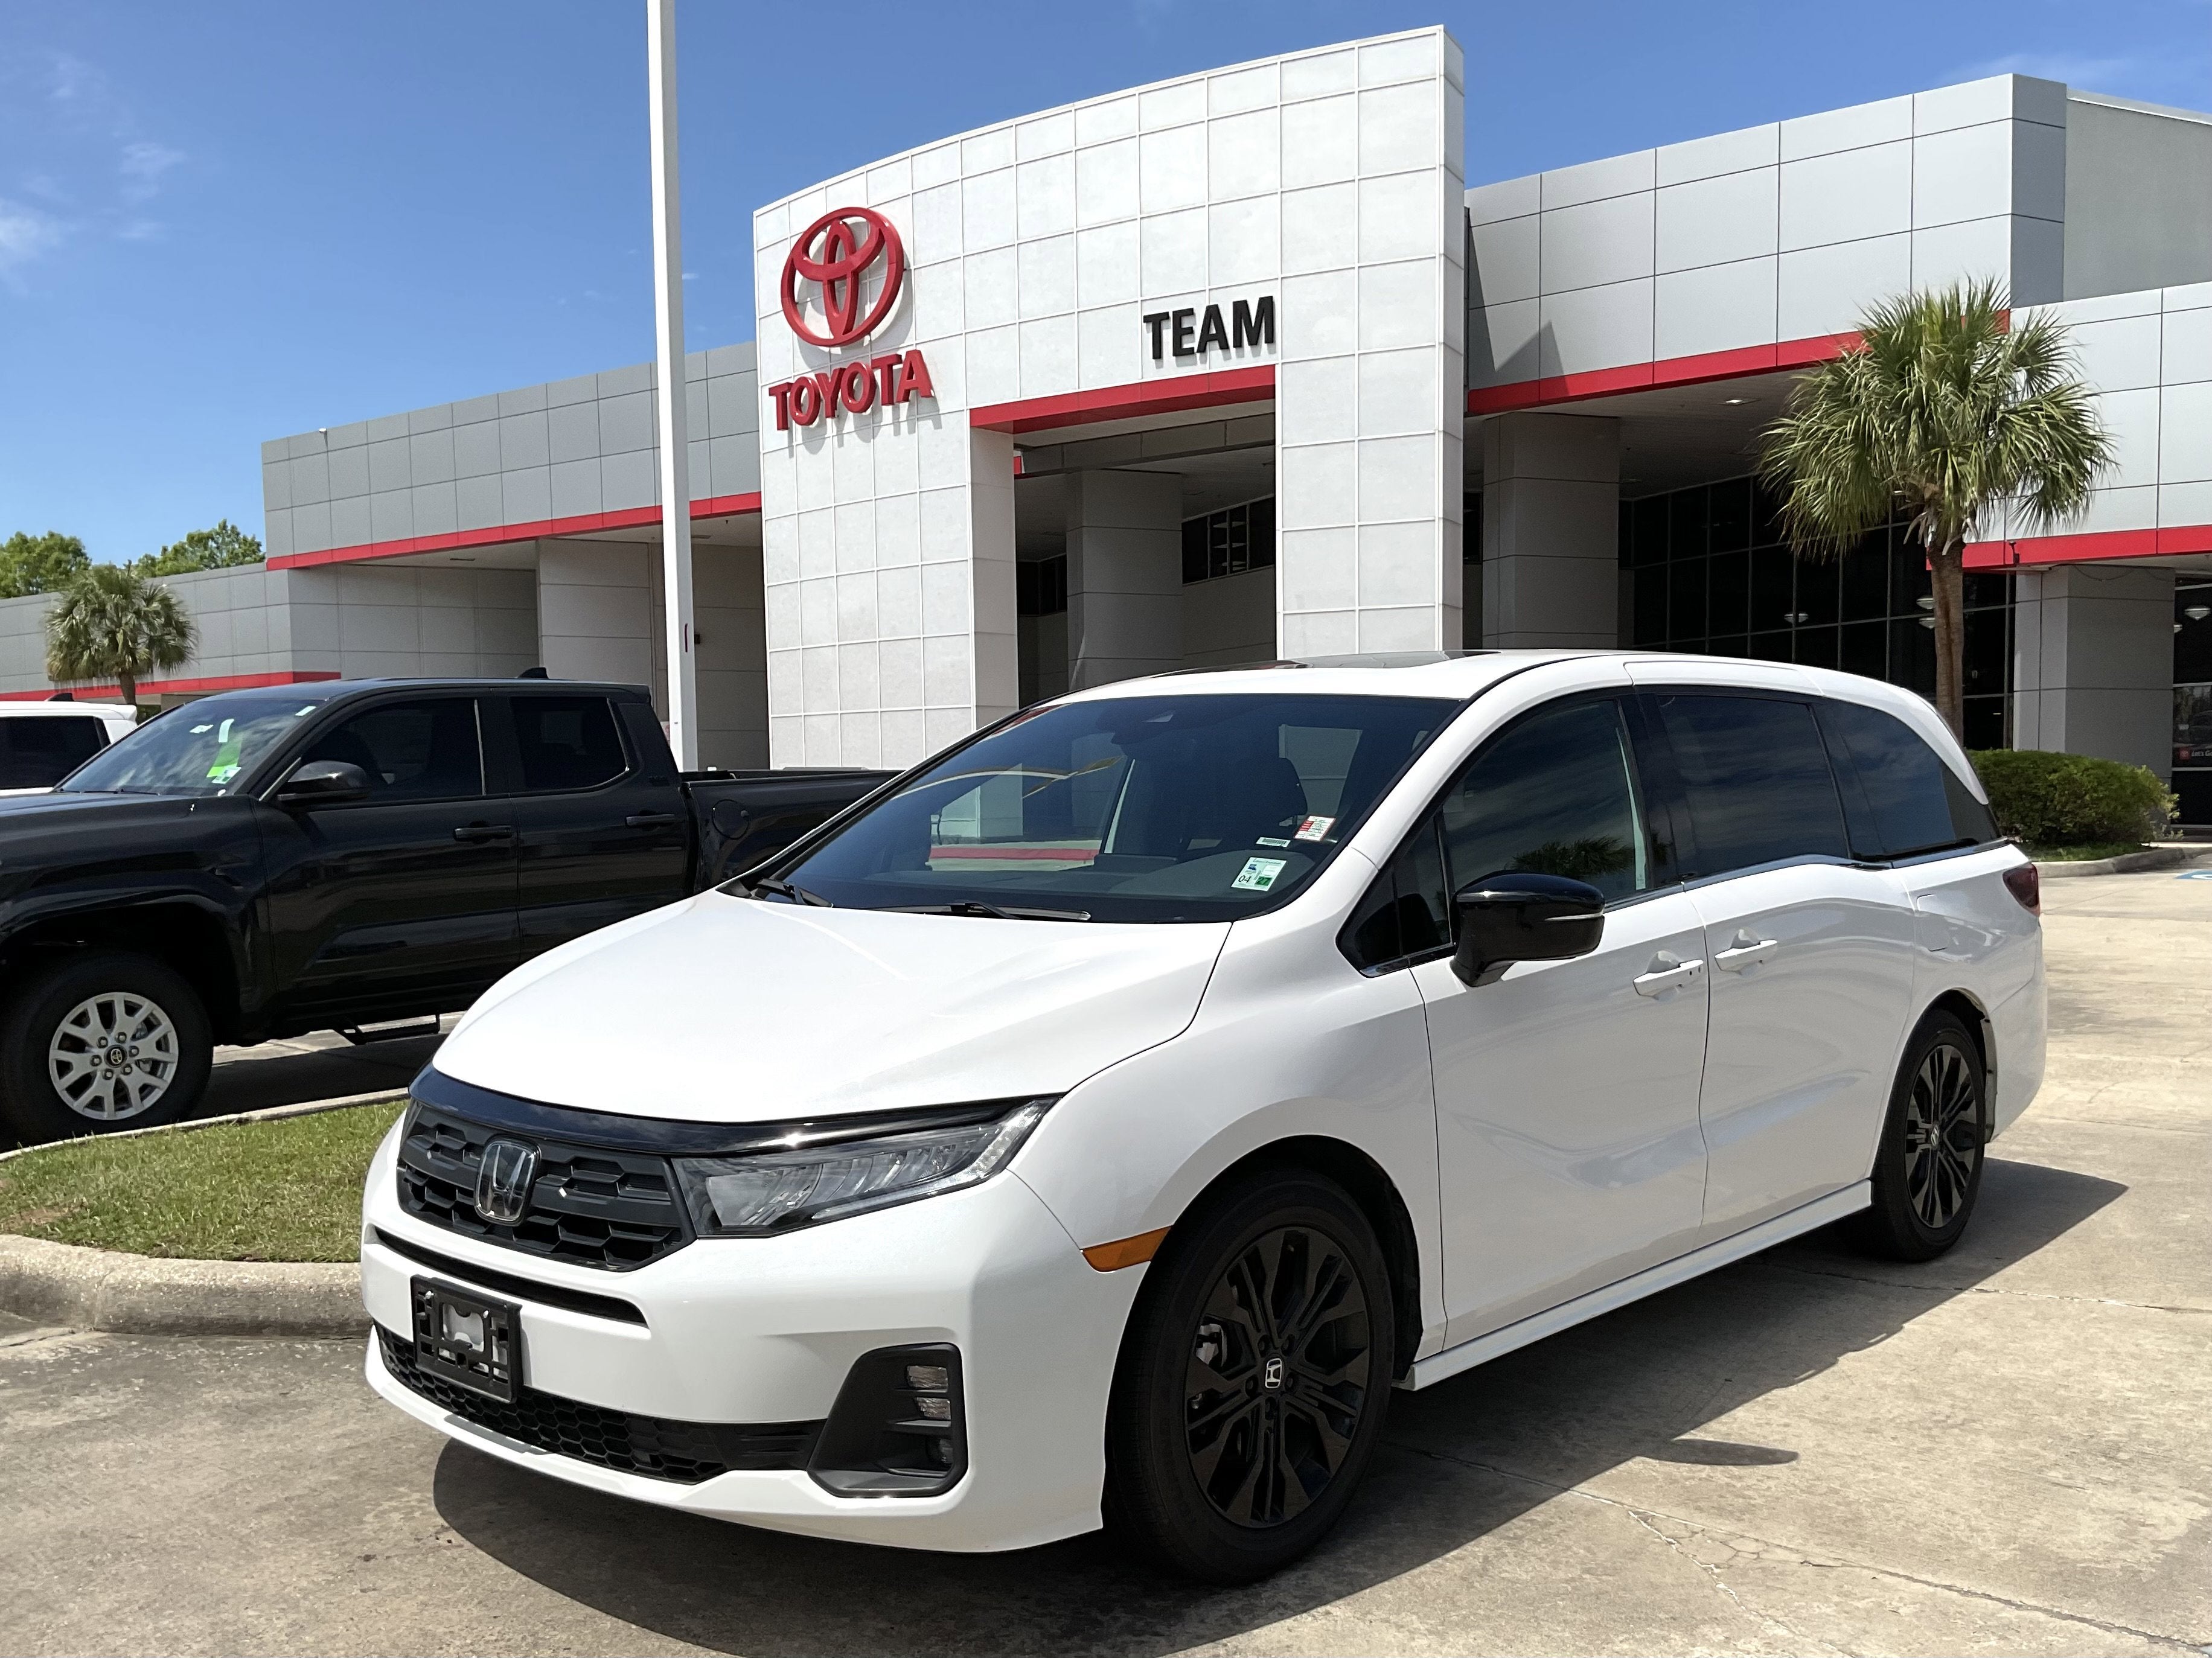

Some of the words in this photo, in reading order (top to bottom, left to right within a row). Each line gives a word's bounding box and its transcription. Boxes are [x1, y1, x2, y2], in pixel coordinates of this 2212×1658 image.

[1143, 295, 1274, 360] TEAM
[769, 349, 935, 430] TOYOTA
[1256, 876, 1273, 885] 27
